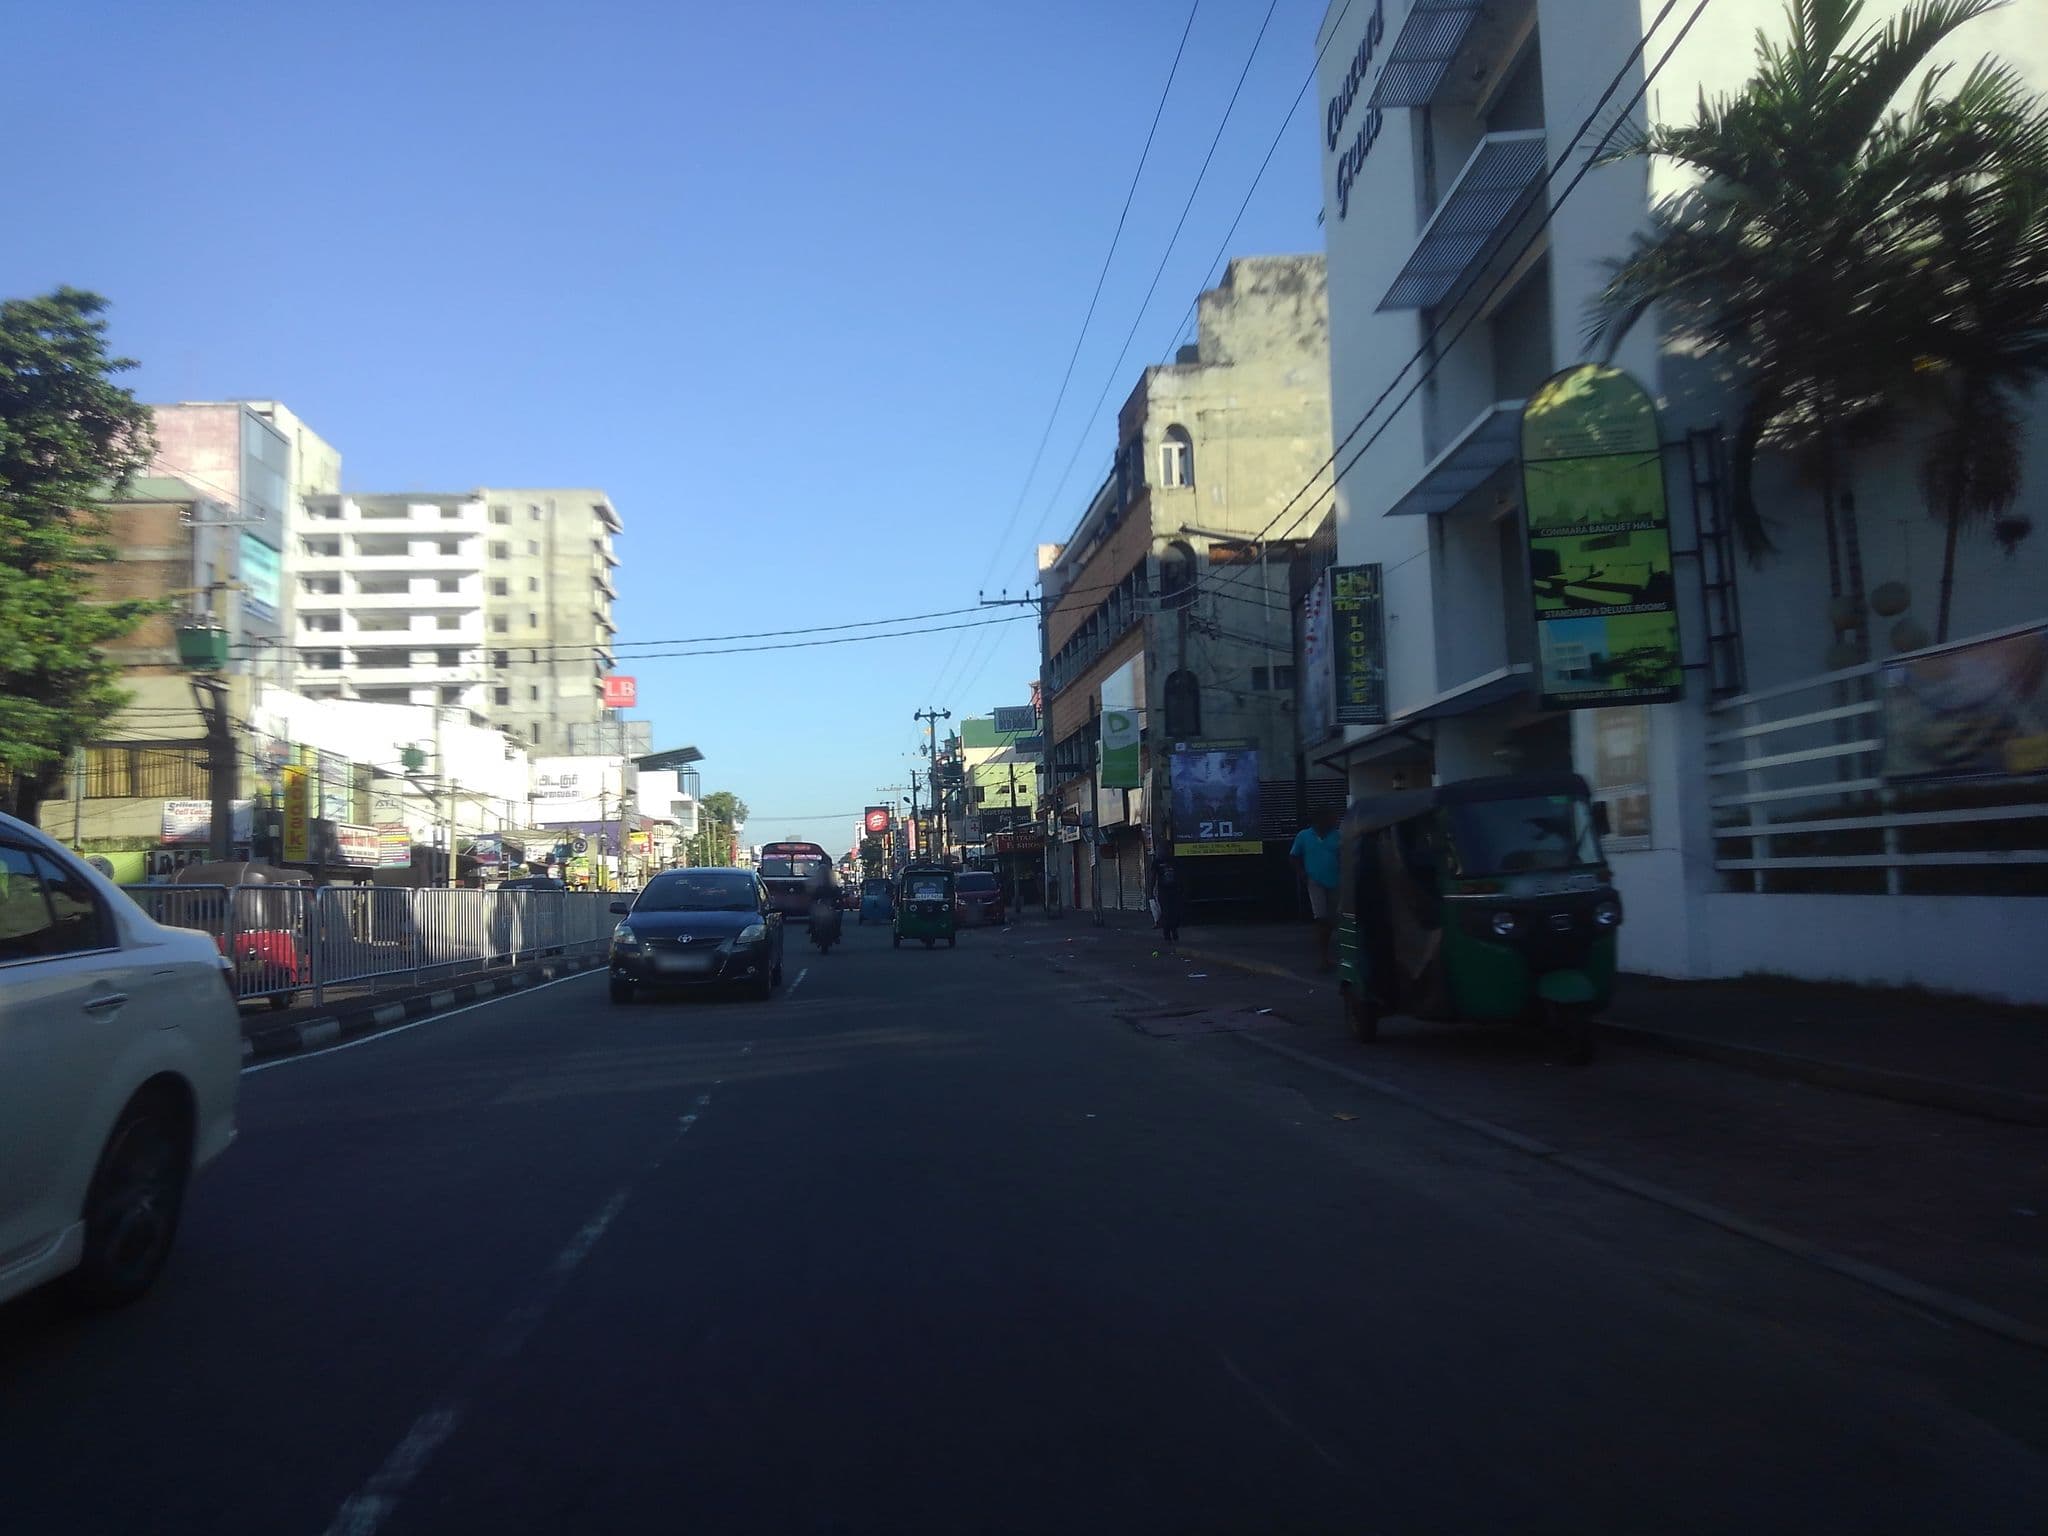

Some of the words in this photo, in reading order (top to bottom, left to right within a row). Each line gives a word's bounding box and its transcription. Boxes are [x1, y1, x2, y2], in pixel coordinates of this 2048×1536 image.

[1589, 522, 1631, 533] BANQUET
[1632, 520, 1656, 530] HALL
[1544, 607, 1591, 618] STANDARD
[1601, 604, 1633, 615] DELUXE
[1634, 602, 1667, 612] ROOMS
[606, 681, 635, 697] LB
